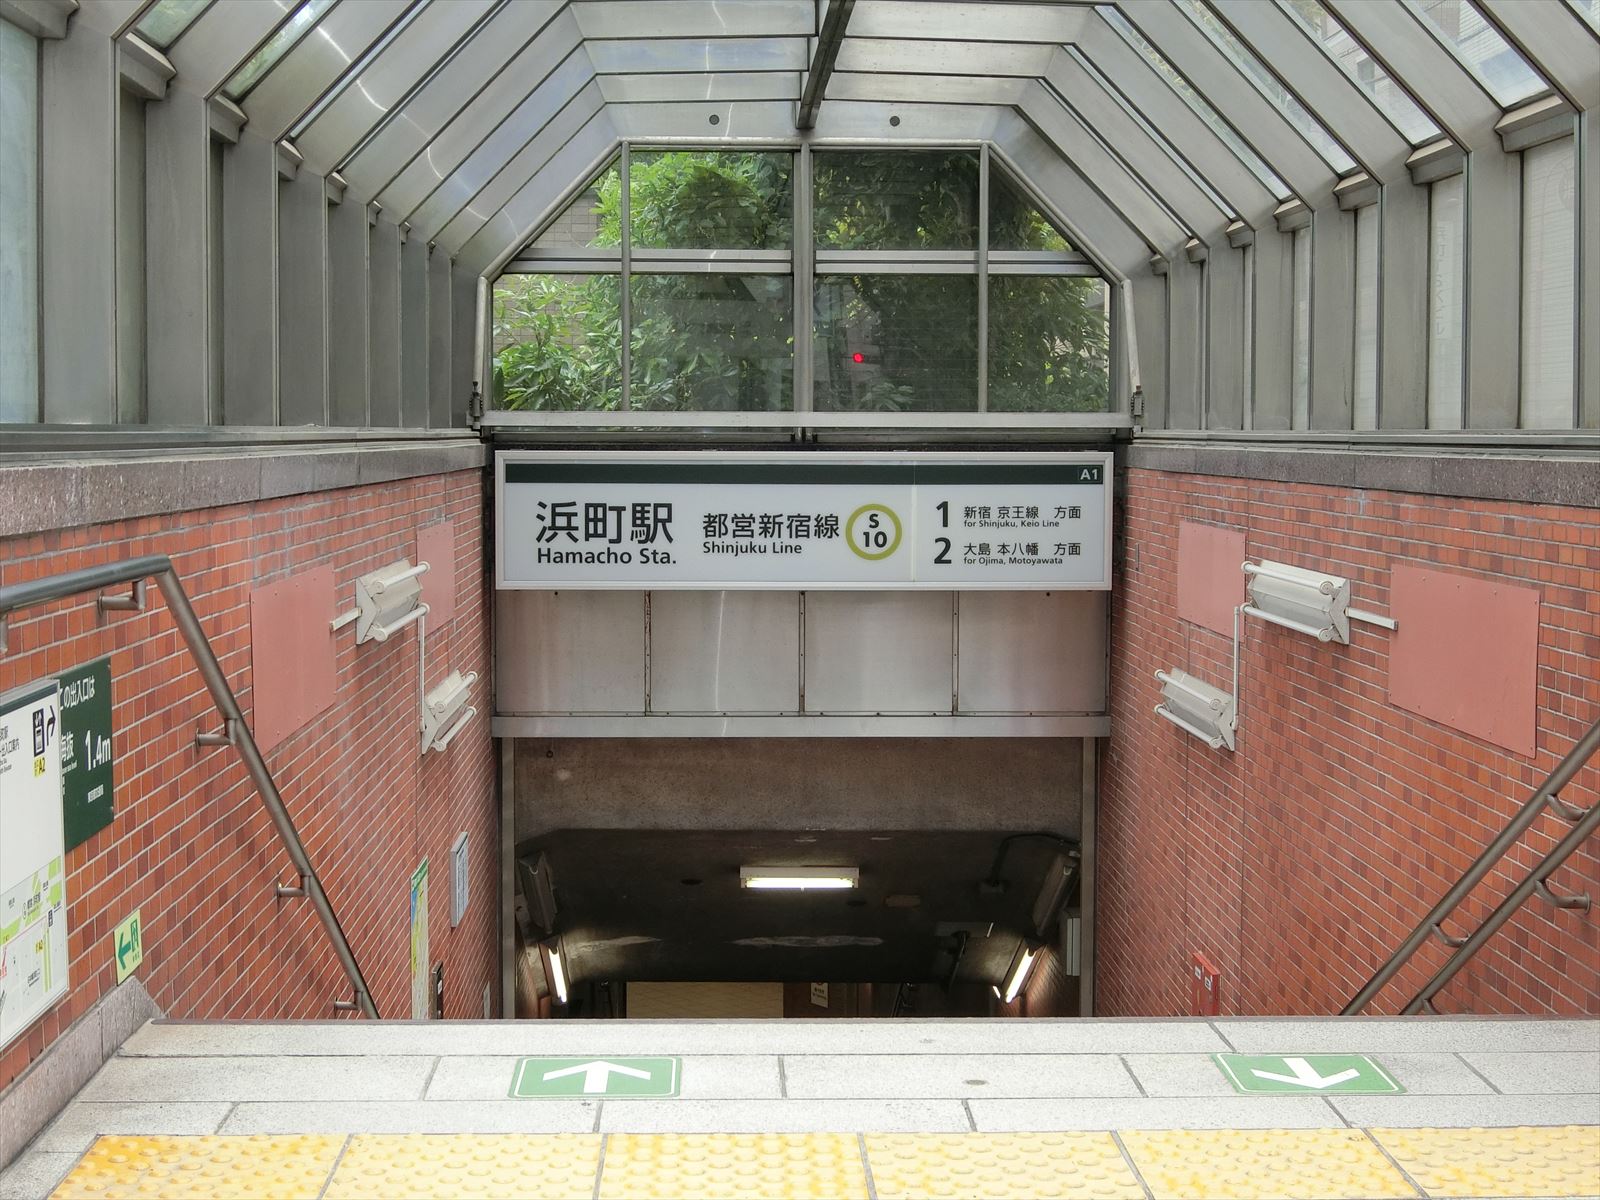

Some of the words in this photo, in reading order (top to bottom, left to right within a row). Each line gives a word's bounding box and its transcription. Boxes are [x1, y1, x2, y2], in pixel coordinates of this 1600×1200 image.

[1080, 468, 1099, 481] A1
[536, 501, 674, 544] 浜町駅
[868, 512, 880, 528] S
[936, 501, 949, 528] 1
[964, 506, 991, 520] 新宿
[997, 506, 1040, 520] 京王線
[1053, 506, 1081, 520] 方面
[703, 513, 840, 539] 都営新宿線
[964, 519, 977, 528] for
[979, 519, 1019, 529] Shinjuku,
[1021, 519, 1040, 528] Keio
[1042, 519, 1060, 528] Line
[862, 530, 888, 548] 10
[538, 546, 633, 565] Hamacho
[639, 546, 677, 565] Sta.
[703, 540, 768, 557] Shinjuku
[772, 541, 803, 555] Line
[934, 537, 952, 564] 2
[964, 542, 991, 556] 大島
[997, 542, 1039, 556] 本八幡
[1053, 542, 1081, 556] 方面
[964, 556, 976, 565] for
[979, 556, 1006, 567] Ojima,
[1008, 556, 1063, 567] Motoyawata
[85, 729, 112, 772] 1.4m
